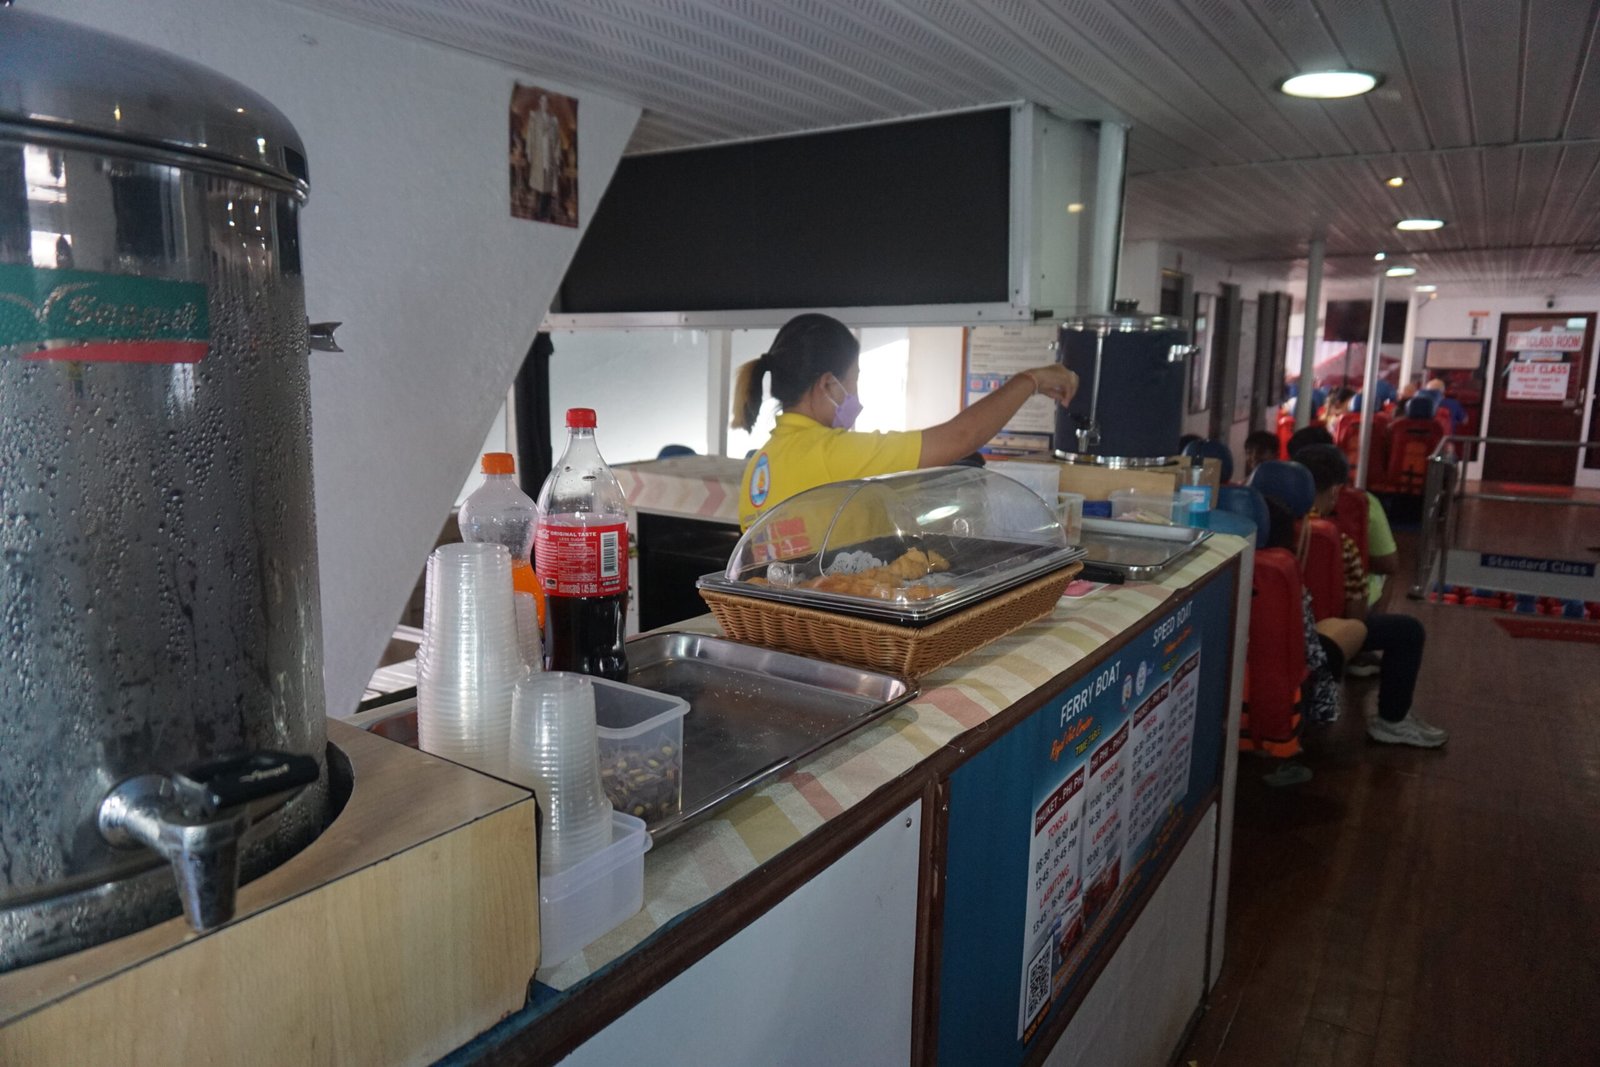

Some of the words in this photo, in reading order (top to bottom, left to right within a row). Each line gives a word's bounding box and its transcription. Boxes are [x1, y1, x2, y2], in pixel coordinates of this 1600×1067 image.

[1531, 336, 1553, 347] CLASS
[1556, 336, 1582, 347] ROOM
[1512, 365, 1535, 373] FIRST
[1539, 365, 1568, 375] CLASS
[1488, 556, 1548, 571] Standard
[1551, 562, 1587, 575] Class
[1153, 616, 1175, 647] SPEED
[1176, 600, 1193, 629] BOAT
[1060, 682, 1095, 727] FERRY
[1095, 661, 1121, 697] BOAT
[1101, 760, 1120, 784] TONSAI
[1062, 781, 1073, 800] PHI
[1048, 809, 1069, 840] TONSAI
[1069, 817, 1079, 834] AM
[1068, 836, 1077, 852] PM
[1040, 864, 1069, 909] LAEMTONG
[1065, 875, 1074, 892] PM
